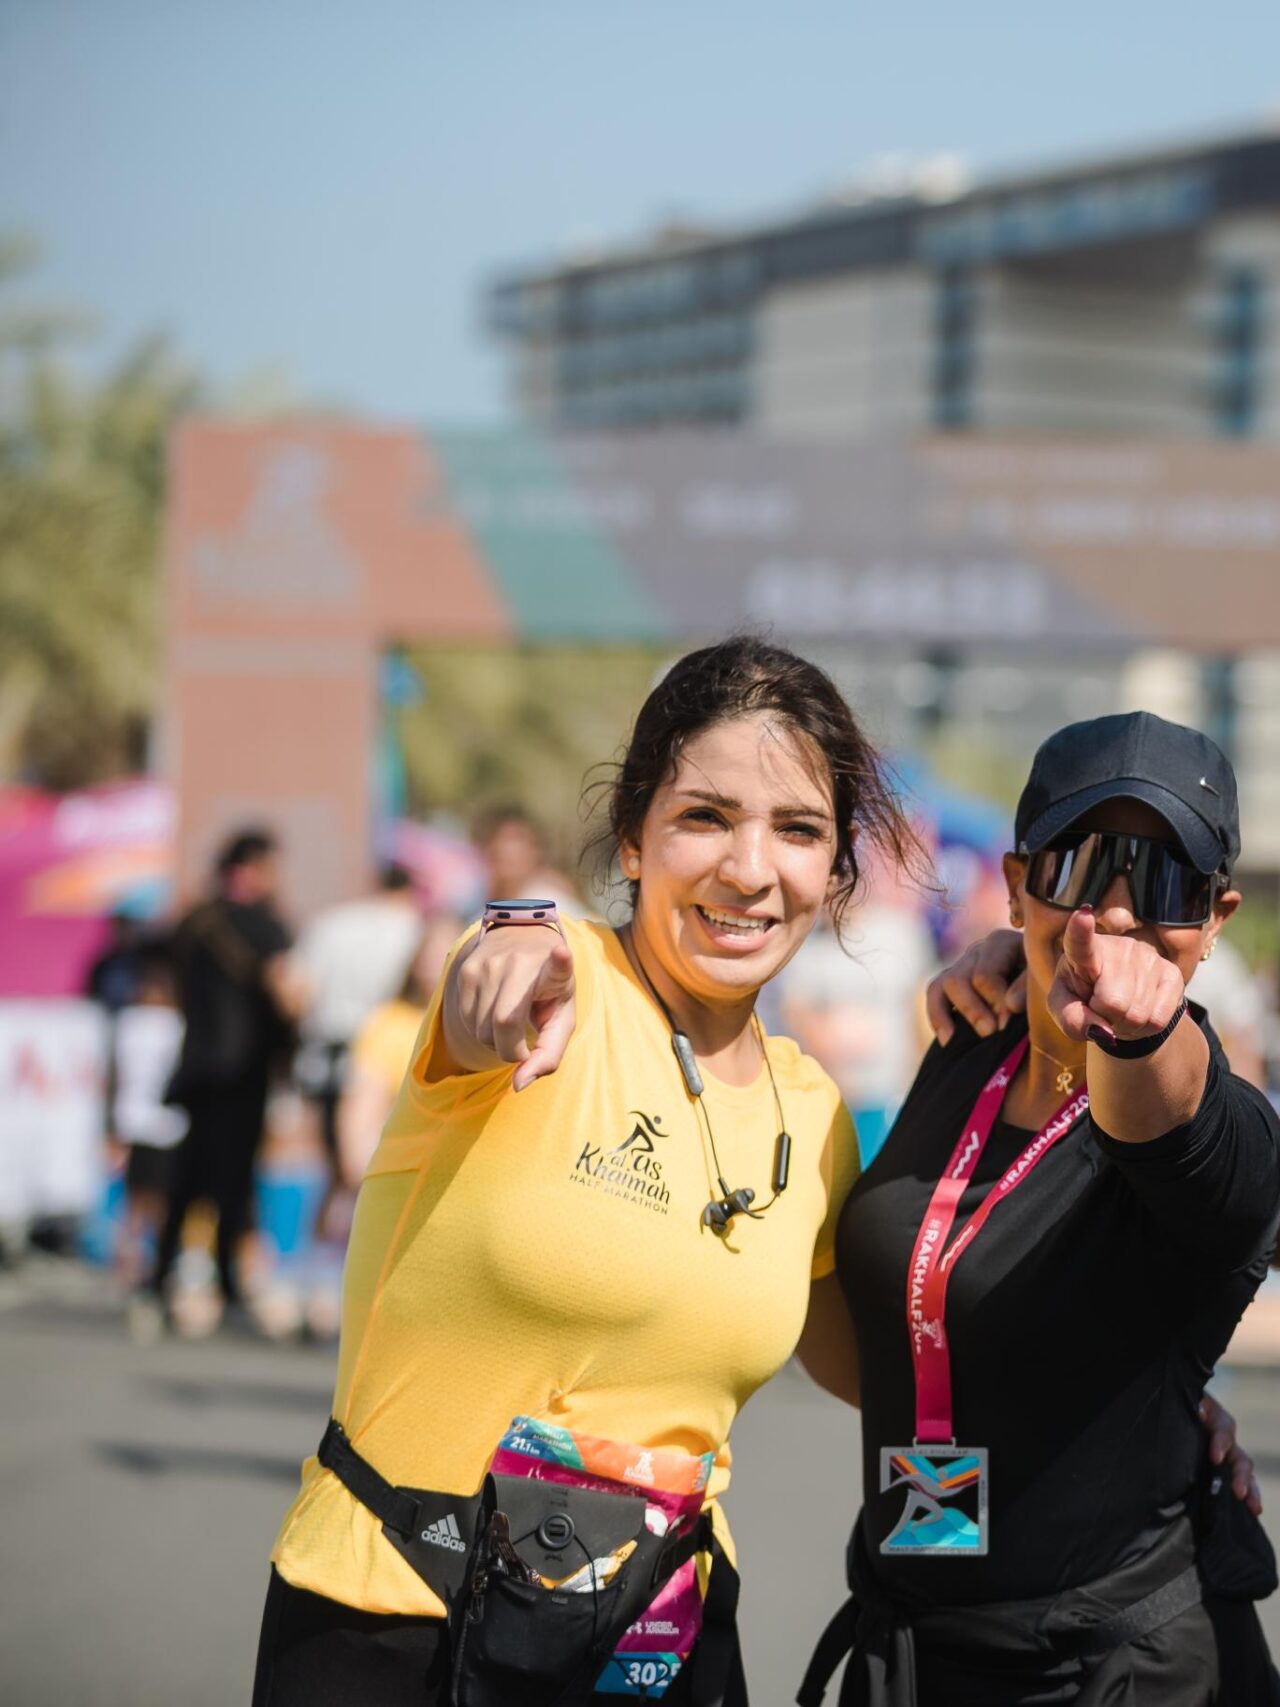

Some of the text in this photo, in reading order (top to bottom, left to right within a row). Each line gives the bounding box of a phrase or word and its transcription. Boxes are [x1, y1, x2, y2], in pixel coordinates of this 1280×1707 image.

[575, 1141, 671, 1205] Khaimah
[999, 1094, 1089, 1191] #RAKHALF20
[421, 1530, 466, 1553] adidas
